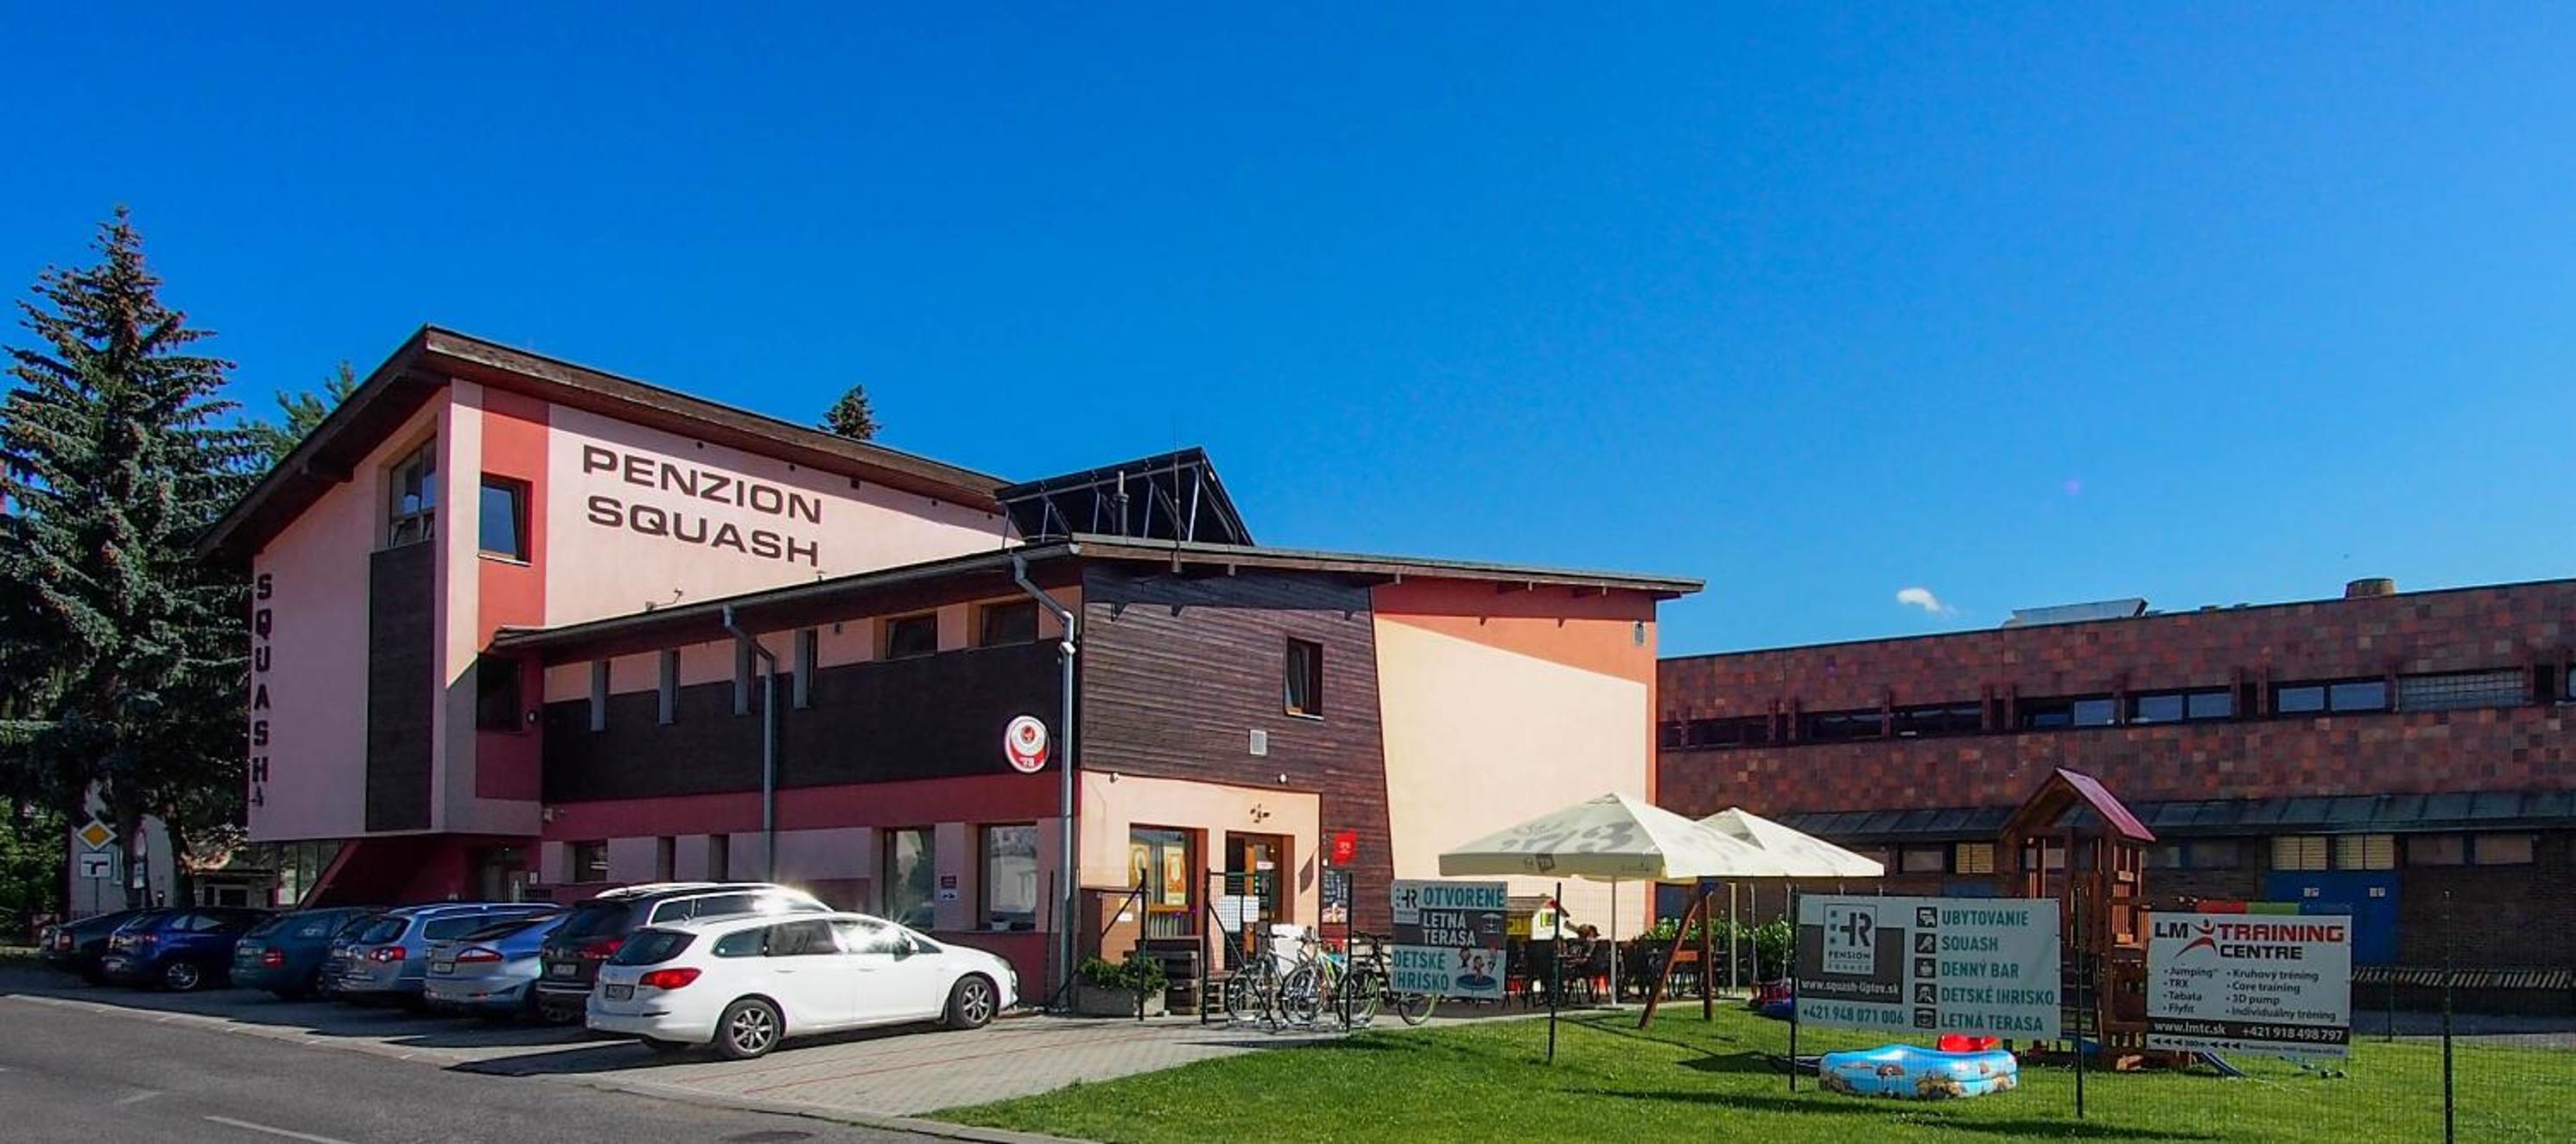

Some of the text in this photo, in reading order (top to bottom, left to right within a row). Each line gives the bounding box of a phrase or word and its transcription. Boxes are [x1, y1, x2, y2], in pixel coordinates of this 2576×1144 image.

[583, 443, 822, 524] PENZION
[587, 494, 819, 568] SQUASH
[252, 573, 272, 783] SQUASH
[1422, 911, 1467, 930] LETNÁ
[1941, 910, 2030, 926] UBYTOVANIE
[1423, 929, 1476, 947] TERASA
[2154, 921, 2345, 943] LM TRAINING
[1829, 950, 1871, 960] PENSION
[2220, 944, 2303, 960] CENTRE
[1991, 963, 2019, 978] BAR
[1393, 971, 1450, 992] IHRISKO
[2170, 979, 2188, 989] TRX
[2232, 981, 2300, 995] Core training
[1996, 989, 2055, 1006] IHRISKO
[2169, 991, 2203, 1001] Tabata
[2232, 994, 2281, 1007] 3D pump
[1803, 1006, 1829, 1020] +421
[1857, 1008, 1878, 1023] 071
[1989, 1014, 2044, 1032] TERASA
[2154, 1022, 2344, 1042] www.lmtc.sk +421 918 498 797
